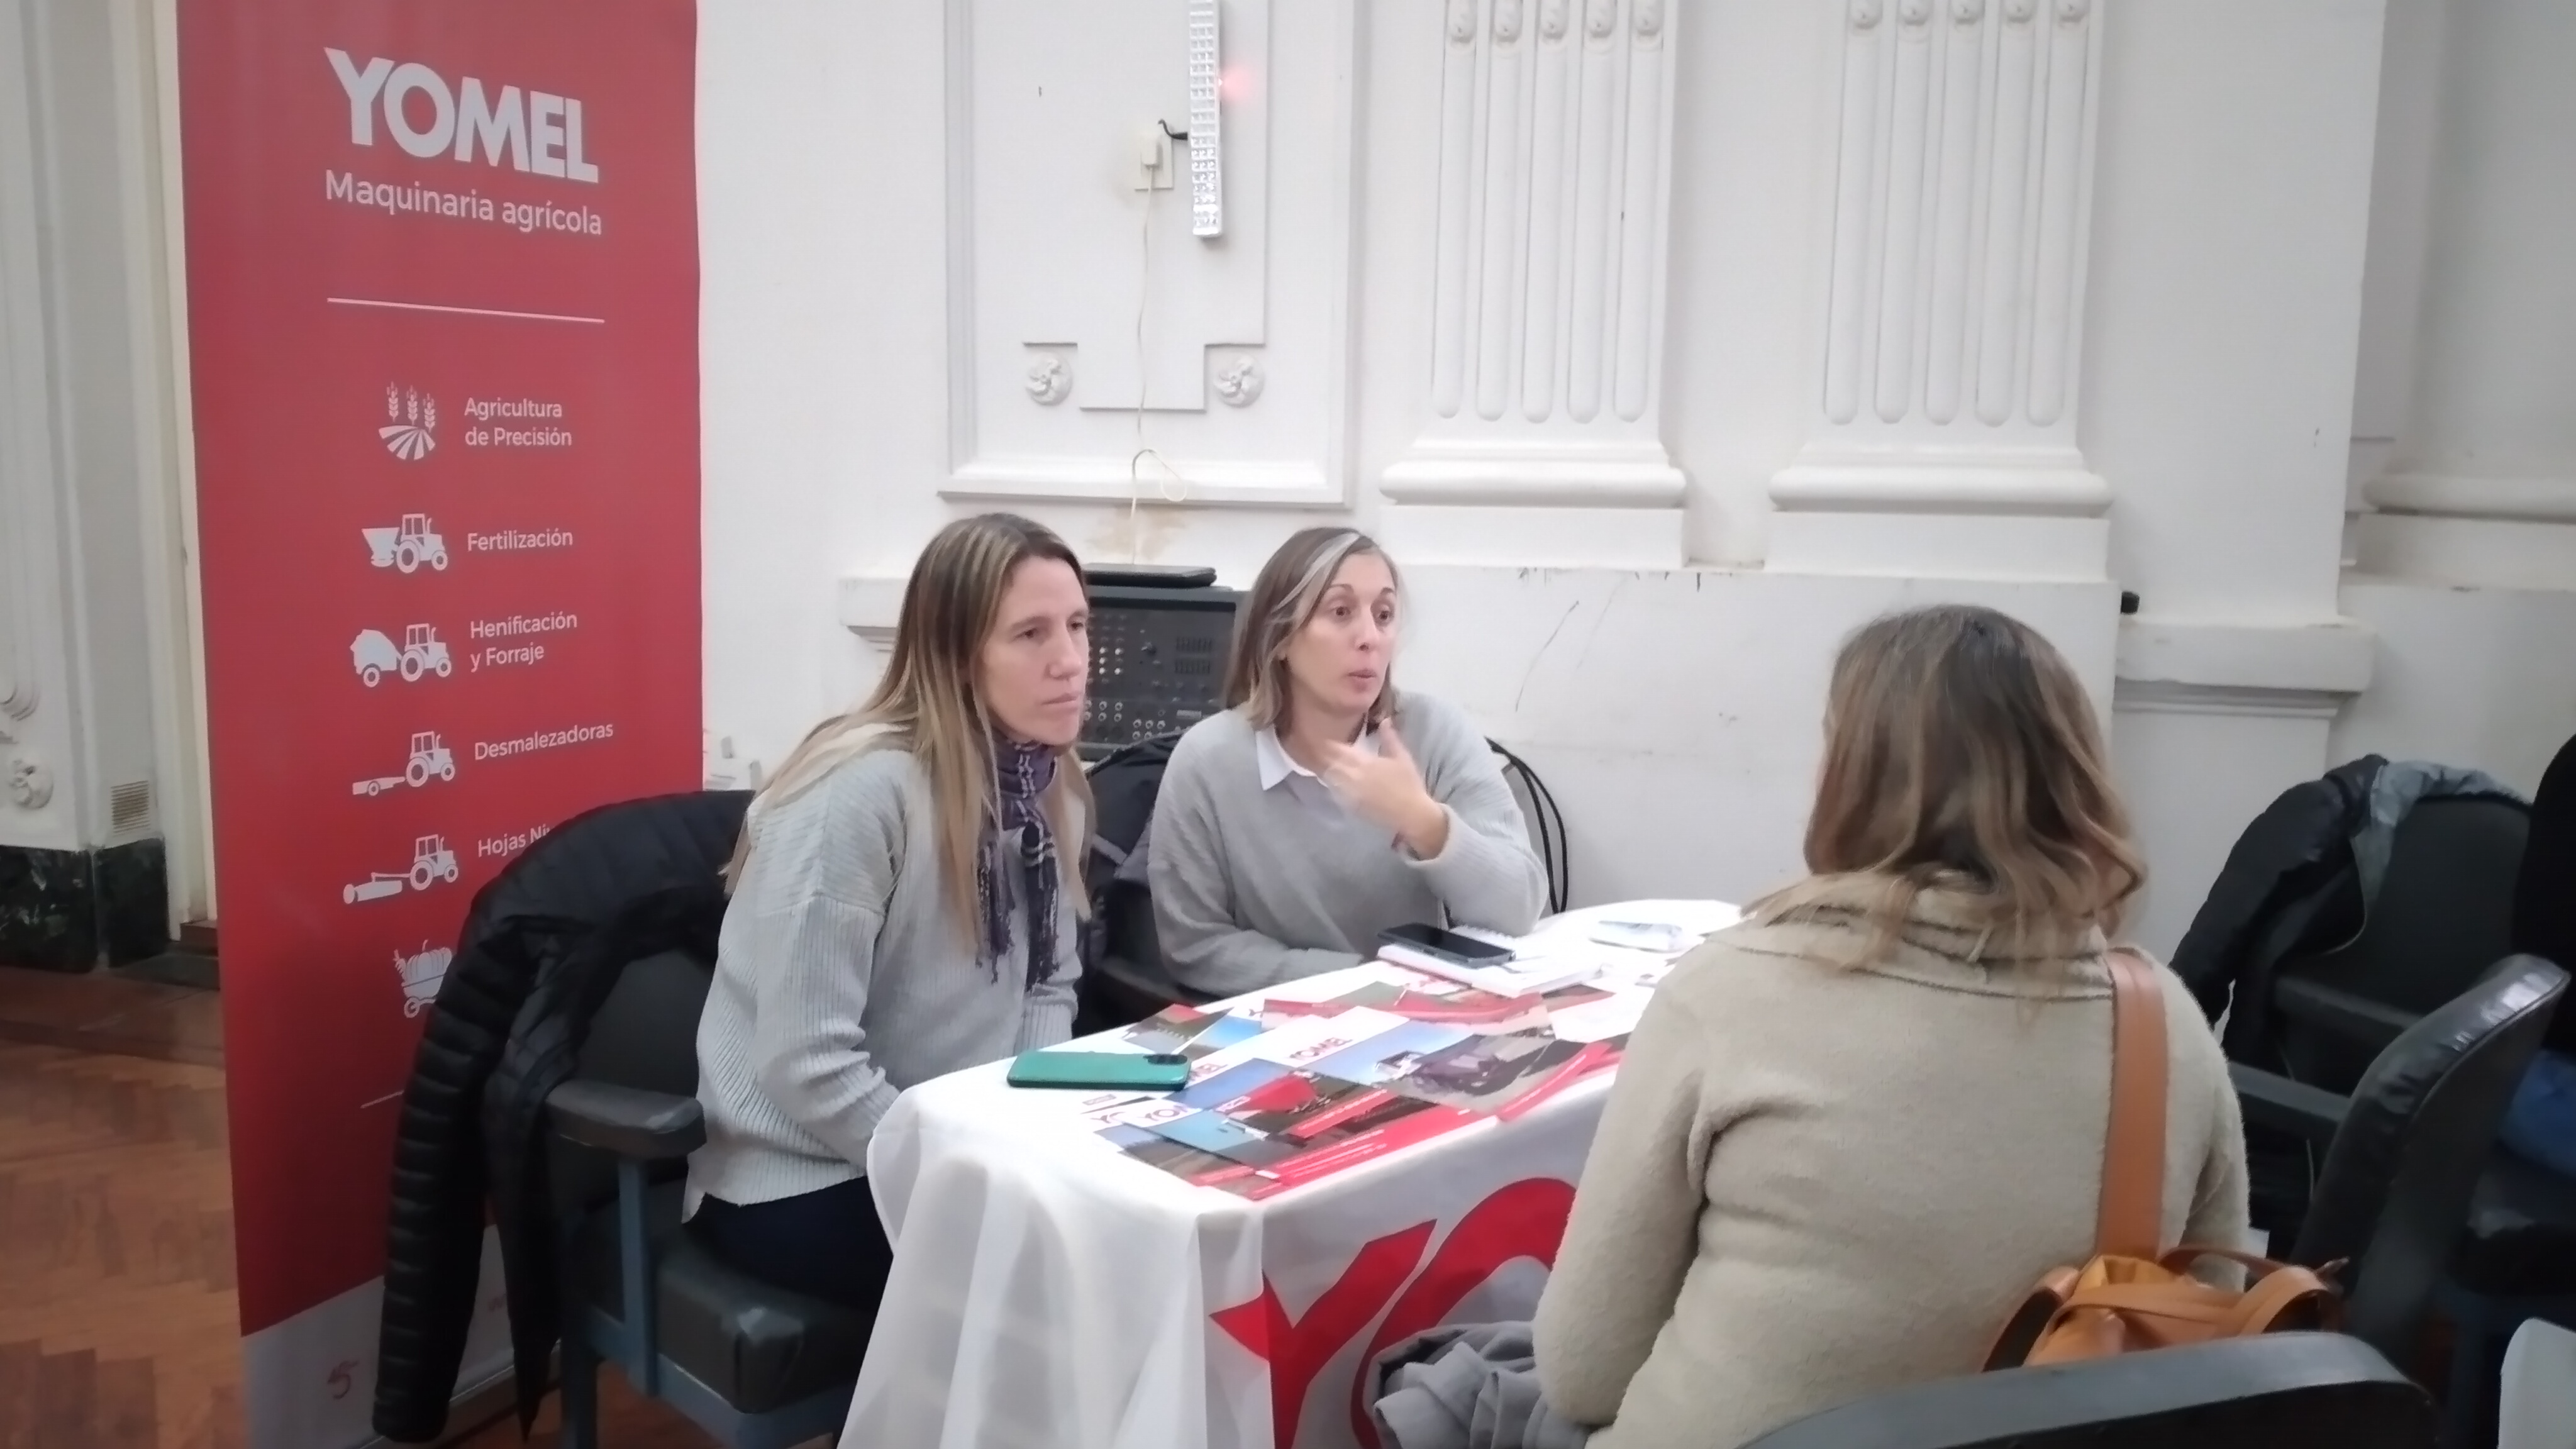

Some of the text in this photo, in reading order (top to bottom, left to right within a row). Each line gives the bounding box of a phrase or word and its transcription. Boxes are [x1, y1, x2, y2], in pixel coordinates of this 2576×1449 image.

[324, 47, 599, 183] YOMEL
[326, 169, 602, 235] Maquinaria agrícola
[464, 397, 563, 420] Agricultura
[465, 426, 572, 446] de Precisión
[467, 527, 574, 552] Fertilización
[470, 611, 578, 639] Henificación
[470, 642, 545, 672] y Forraje
[475, 723, 614, 760] Desmalezadoras
[478, 834, 526, 858] Hojas
